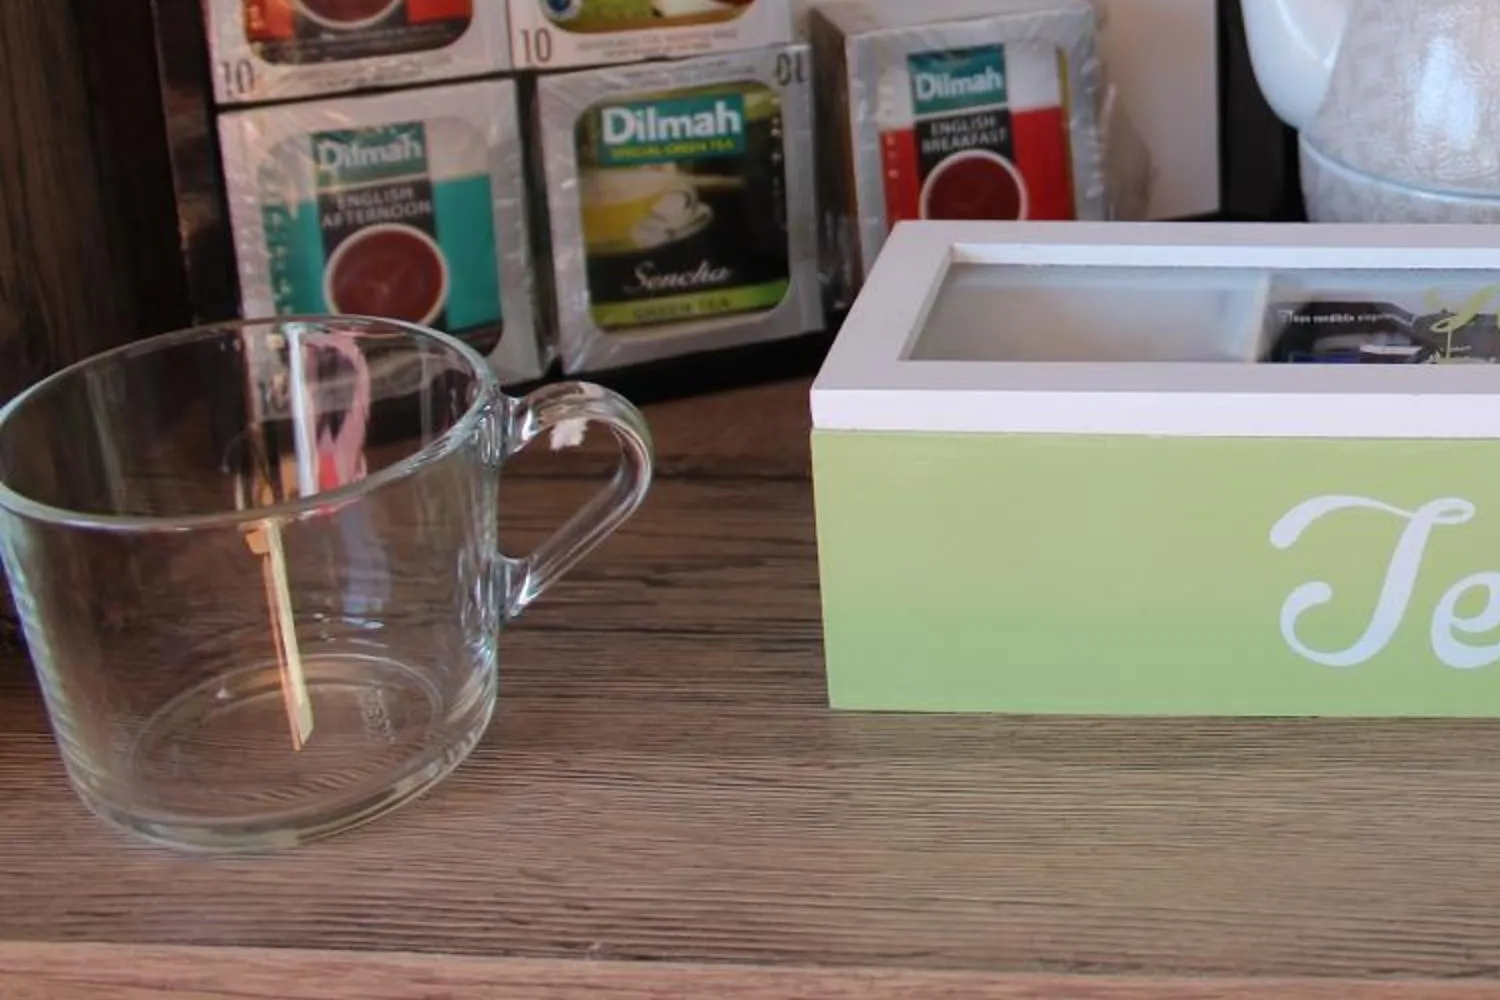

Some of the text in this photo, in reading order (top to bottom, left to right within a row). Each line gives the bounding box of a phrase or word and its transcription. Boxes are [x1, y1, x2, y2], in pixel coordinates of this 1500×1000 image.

[521, 28, 552, 64] 10
[221, 59, 256, 96] 10
[916, 65, 1003, 101] Dilmah
[601, 99, 742, 145] Dilmah
[930, 115, 996, 137] ENGLISH
[319, 133, 422, 171] Dilmah
[921, 127, 1007, 153] BREAKFAST
[323, 201, 432, 228] AFTERNOON
[337, 187, 414, 210] ENGLISH
[623, 259, 736, 294] Sencha
